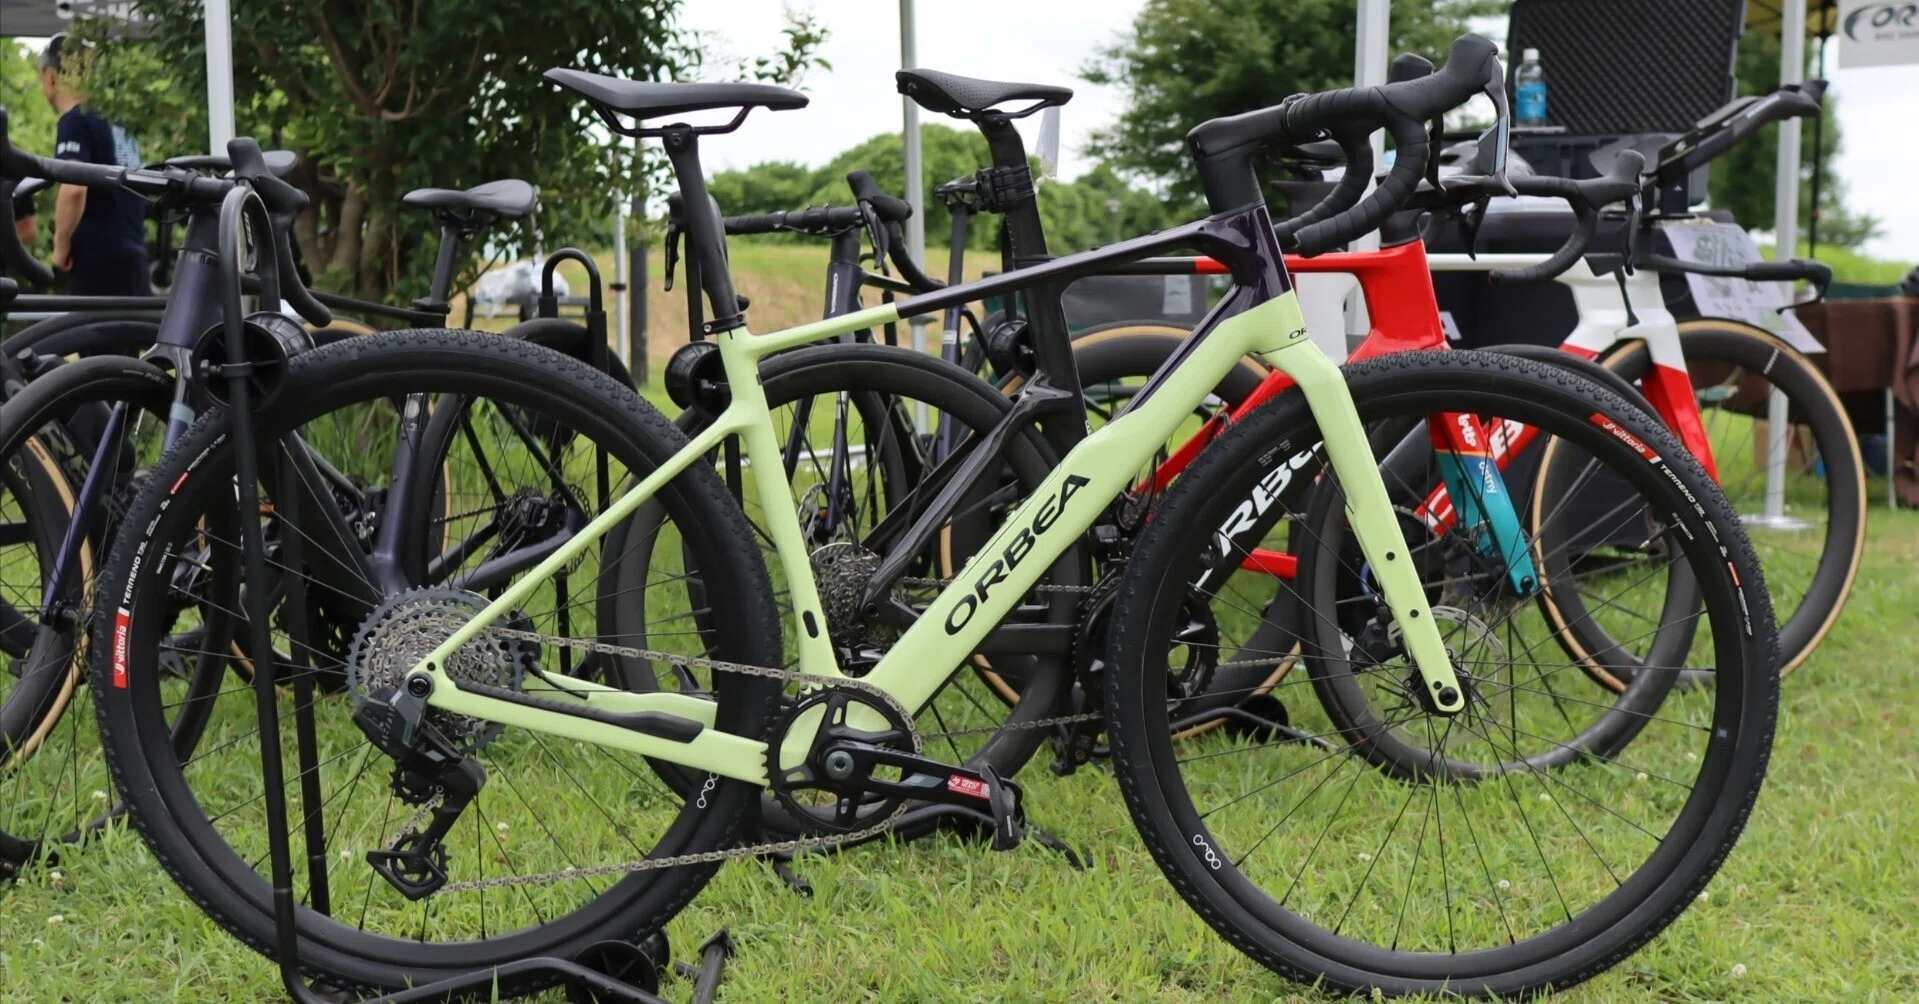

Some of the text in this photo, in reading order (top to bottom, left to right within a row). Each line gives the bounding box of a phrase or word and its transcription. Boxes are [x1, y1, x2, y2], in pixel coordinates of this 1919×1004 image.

[1457, 413, 1478, 447] lotto
[1612, 427, 1647, 454] vittoria
[1660, 463, 1696, 504] TERRENO
[944, 473, 1092, 636] ORBEA
[114, 625, 127, 662] vittoria
[122, 555, 142, 605] TERRENO
